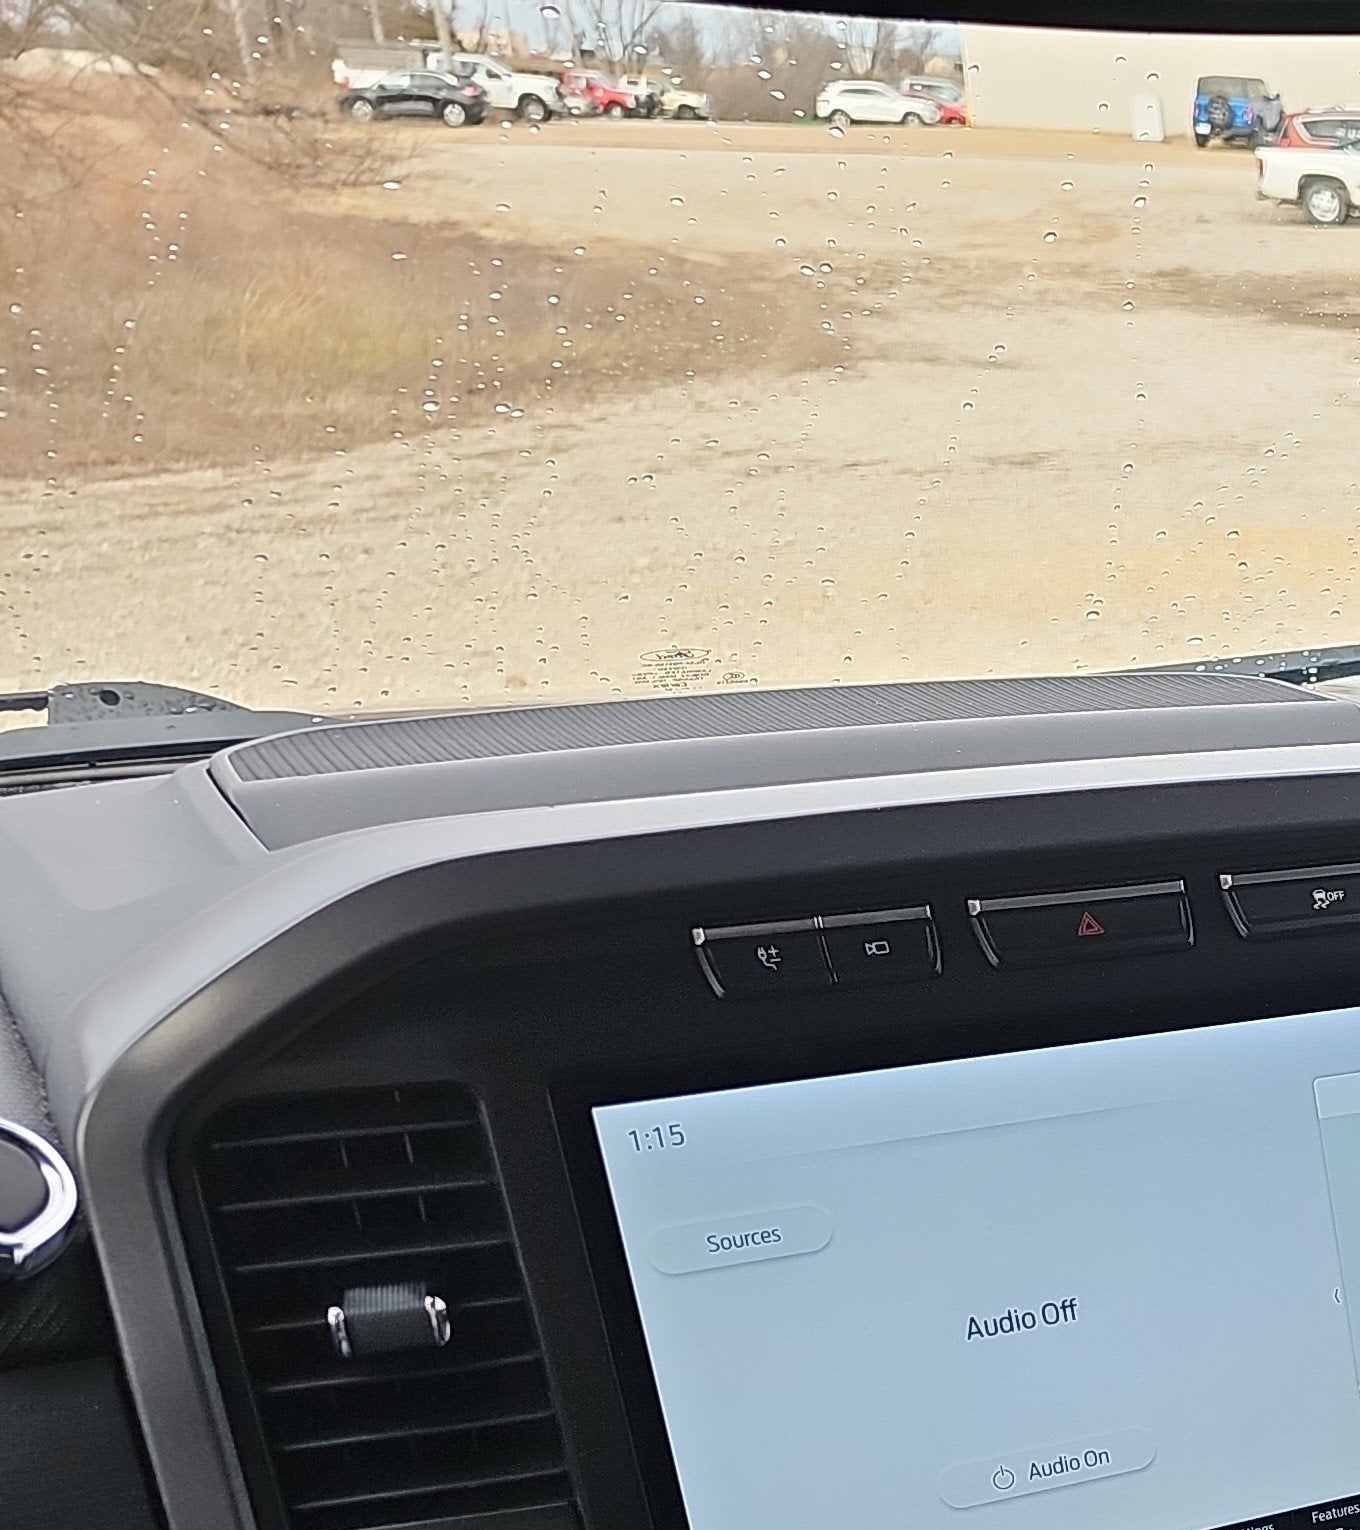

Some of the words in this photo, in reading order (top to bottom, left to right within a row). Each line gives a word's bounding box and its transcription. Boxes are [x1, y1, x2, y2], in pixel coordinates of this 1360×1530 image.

[1327, 890, 1345, 901] OFF
[628, 1123, 686, 1152] 1:15
[706, 1226, 782, 1253] Sources
[966, 1311, 1037, 1340] Audio
[1041, 1298, 1078, 1326] Off
[1028, 1455, 1081, 1481] Audio
[1084, 1450, 1111, 1469] On
[1312, 1503, 1360, 1523] Features
